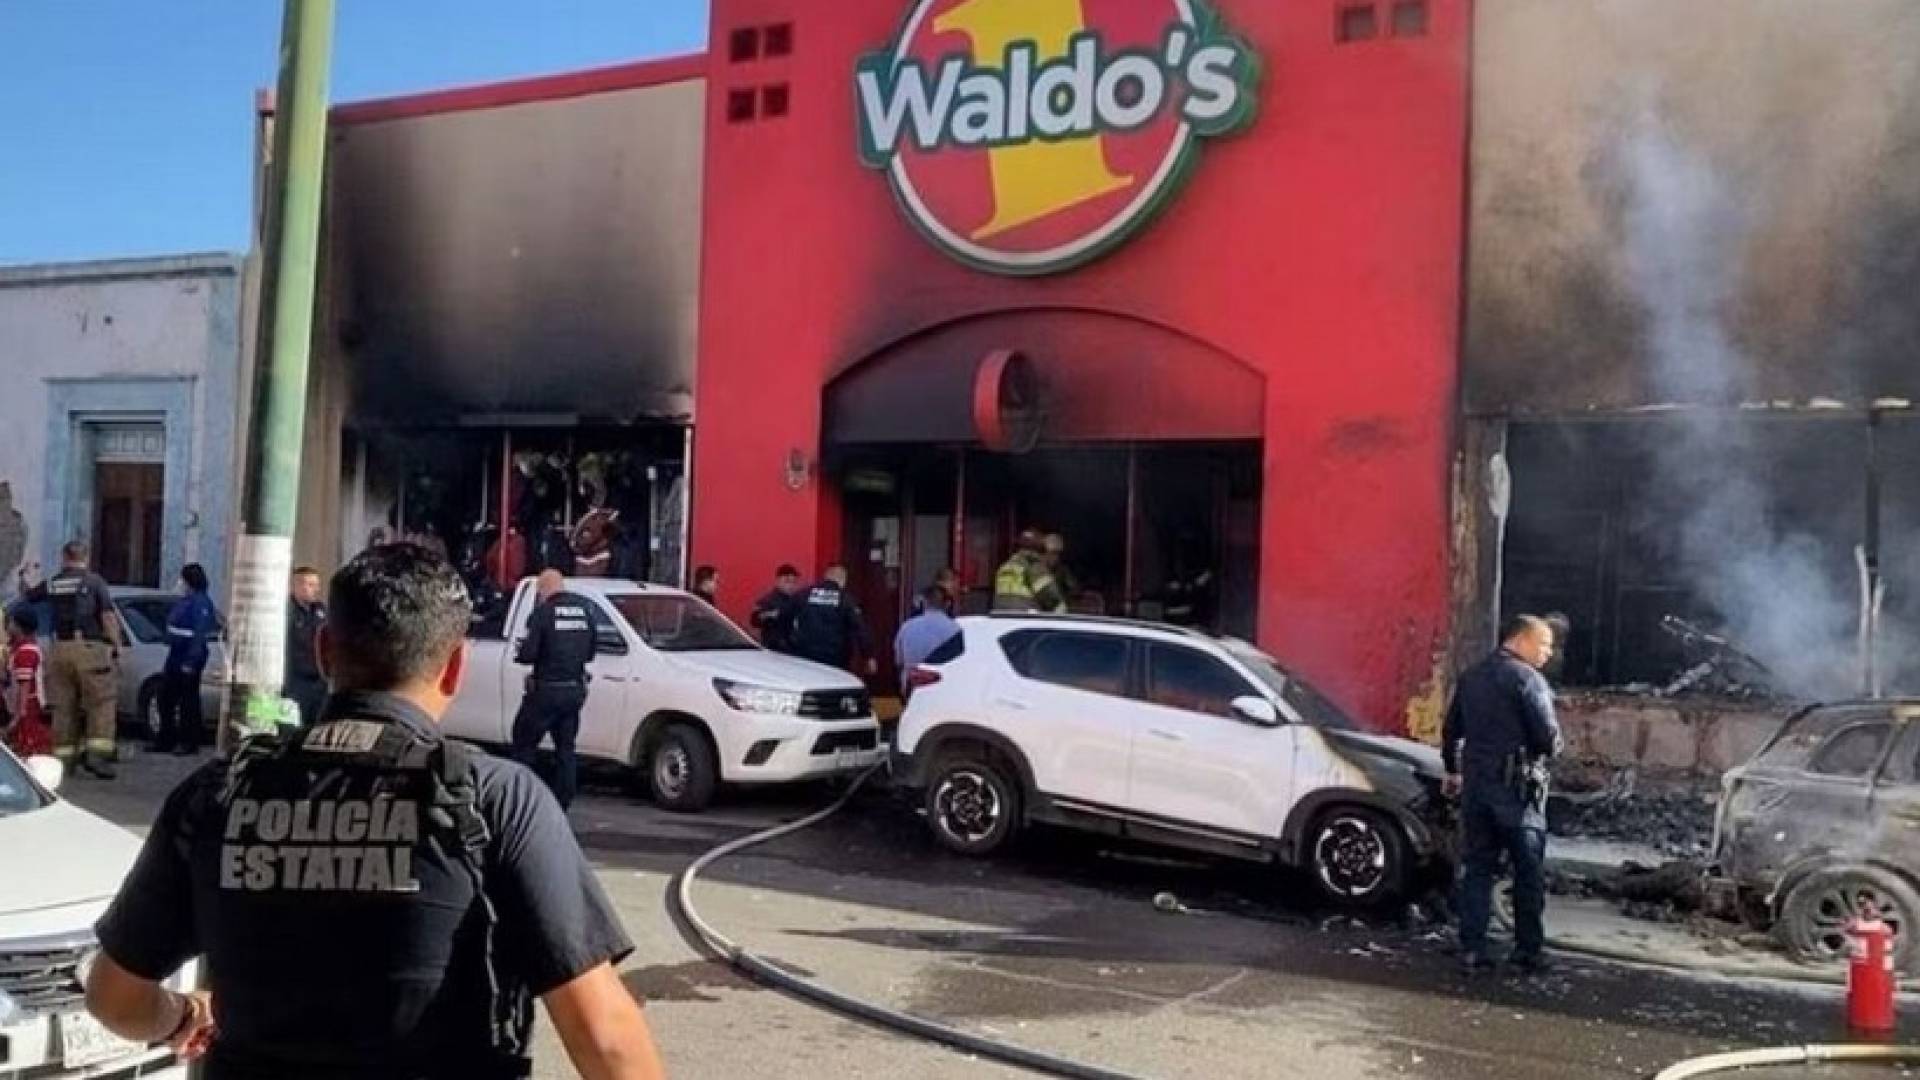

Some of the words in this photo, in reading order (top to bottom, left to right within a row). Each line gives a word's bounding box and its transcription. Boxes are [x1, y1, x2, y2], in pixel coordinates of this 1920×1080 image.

[857, 30, 1239, 153] Waldo's
[224, 791, 419, 842] POLICÍA
[219, 843, 420, 891] ESTATAL
